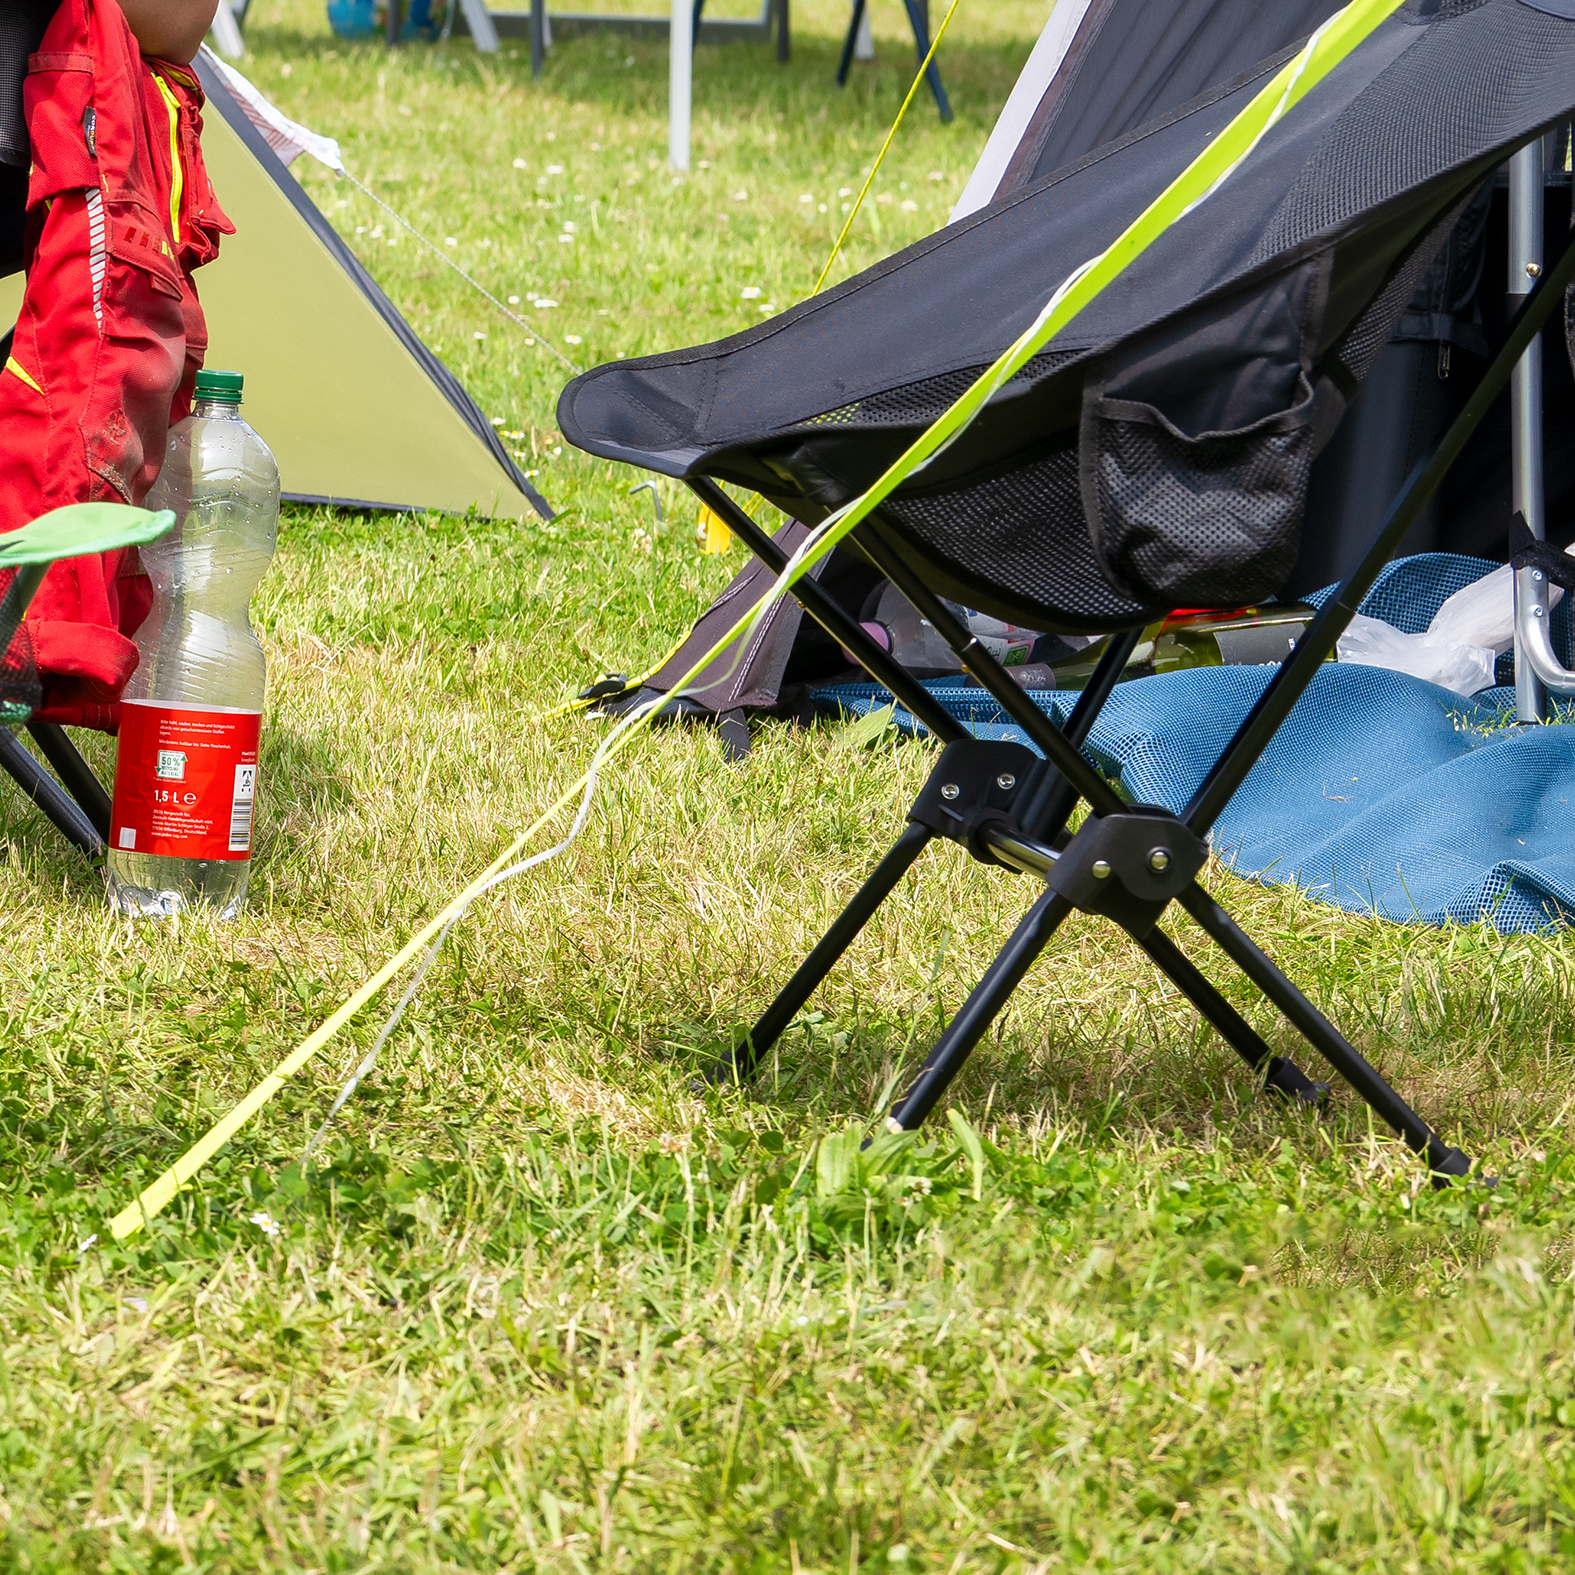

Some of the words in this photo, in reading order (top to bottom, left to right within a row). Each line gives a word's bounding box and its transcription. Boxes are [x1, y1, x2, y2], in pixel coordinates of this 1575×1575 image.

[162, 757, 171, 765] 50
[154, 790, 169, 803] 1,5
[173, 791, 179, 803] L
